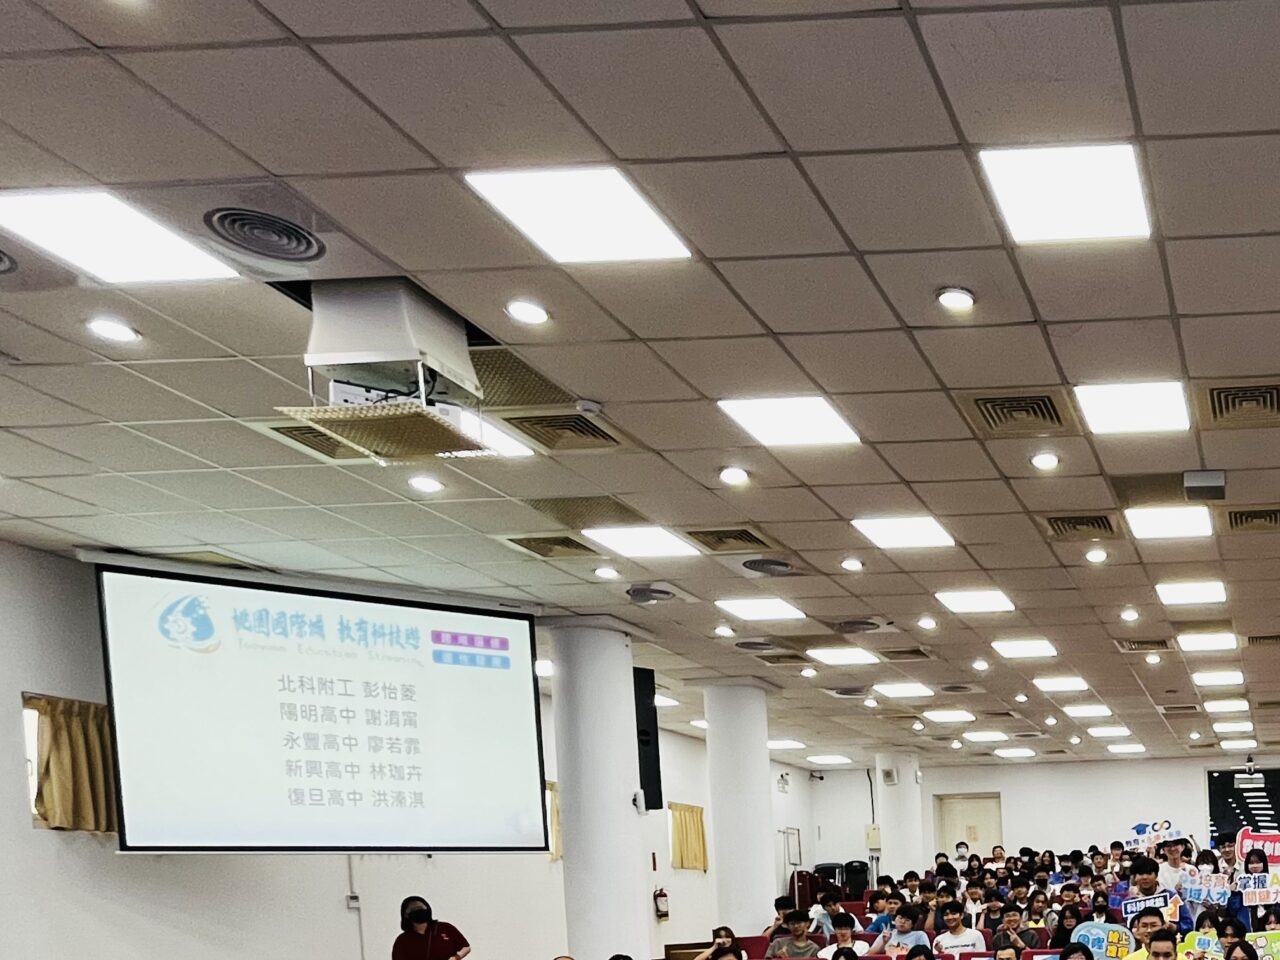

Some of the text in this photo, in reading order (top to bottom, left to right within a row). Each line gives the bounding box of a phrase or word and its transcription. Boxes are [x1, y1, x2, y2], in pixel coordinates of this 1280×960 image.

[278, 674, 355, 697] 北科附工
[280, 702, 356, 724] 陽明高中
[283, 731, 358, 752] 永豐高中
[285, 759, 360, 780] 新興高中
[288, 787, 363, 807] 復旦高中
